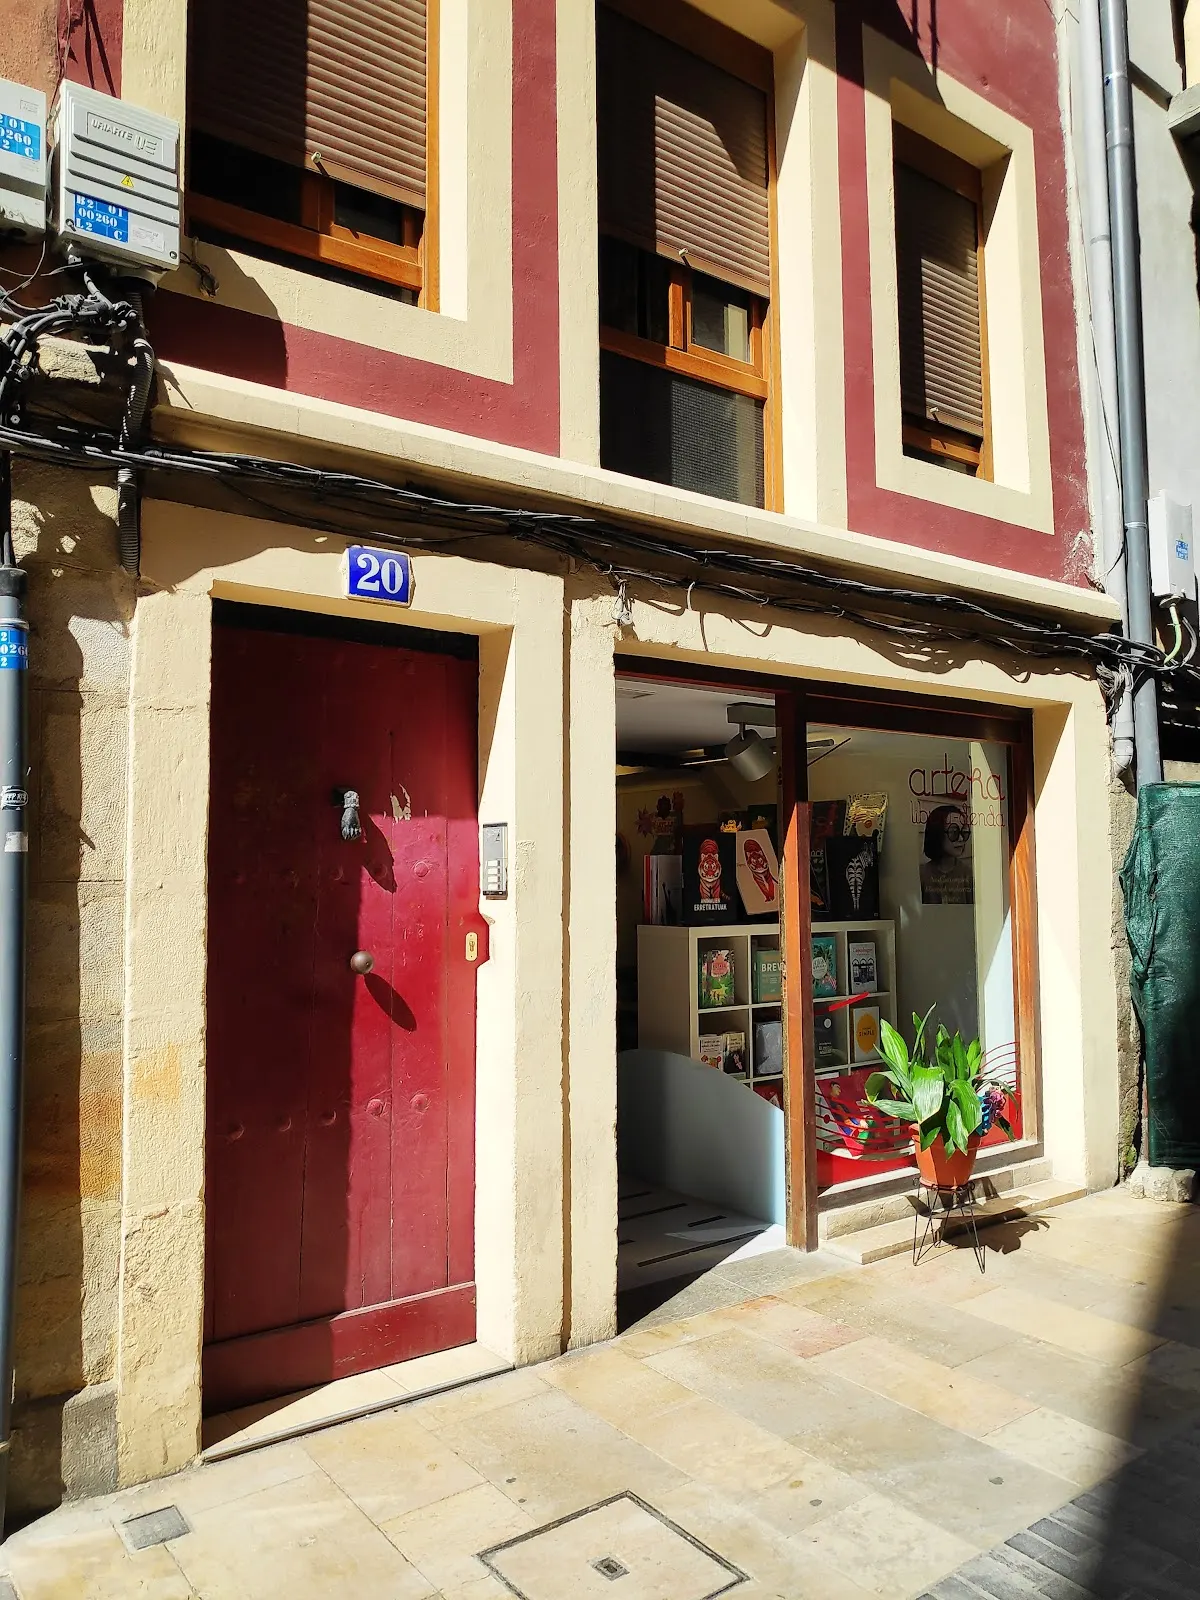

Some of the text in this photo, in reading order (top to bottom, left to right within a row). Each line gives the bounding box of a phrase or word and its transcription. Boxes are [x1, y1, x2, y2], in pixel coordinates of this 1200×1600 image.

[8, 118, 26, 133] 01
[91, 118, 134, 141] URIARTE
[24, 147, 34, 158] C
[75, 195, 123, 218] B2 01
[78, 207, 118, 228] 00260
[113, 230, 123, 241] C
[356, 553, 404, 595] 20
